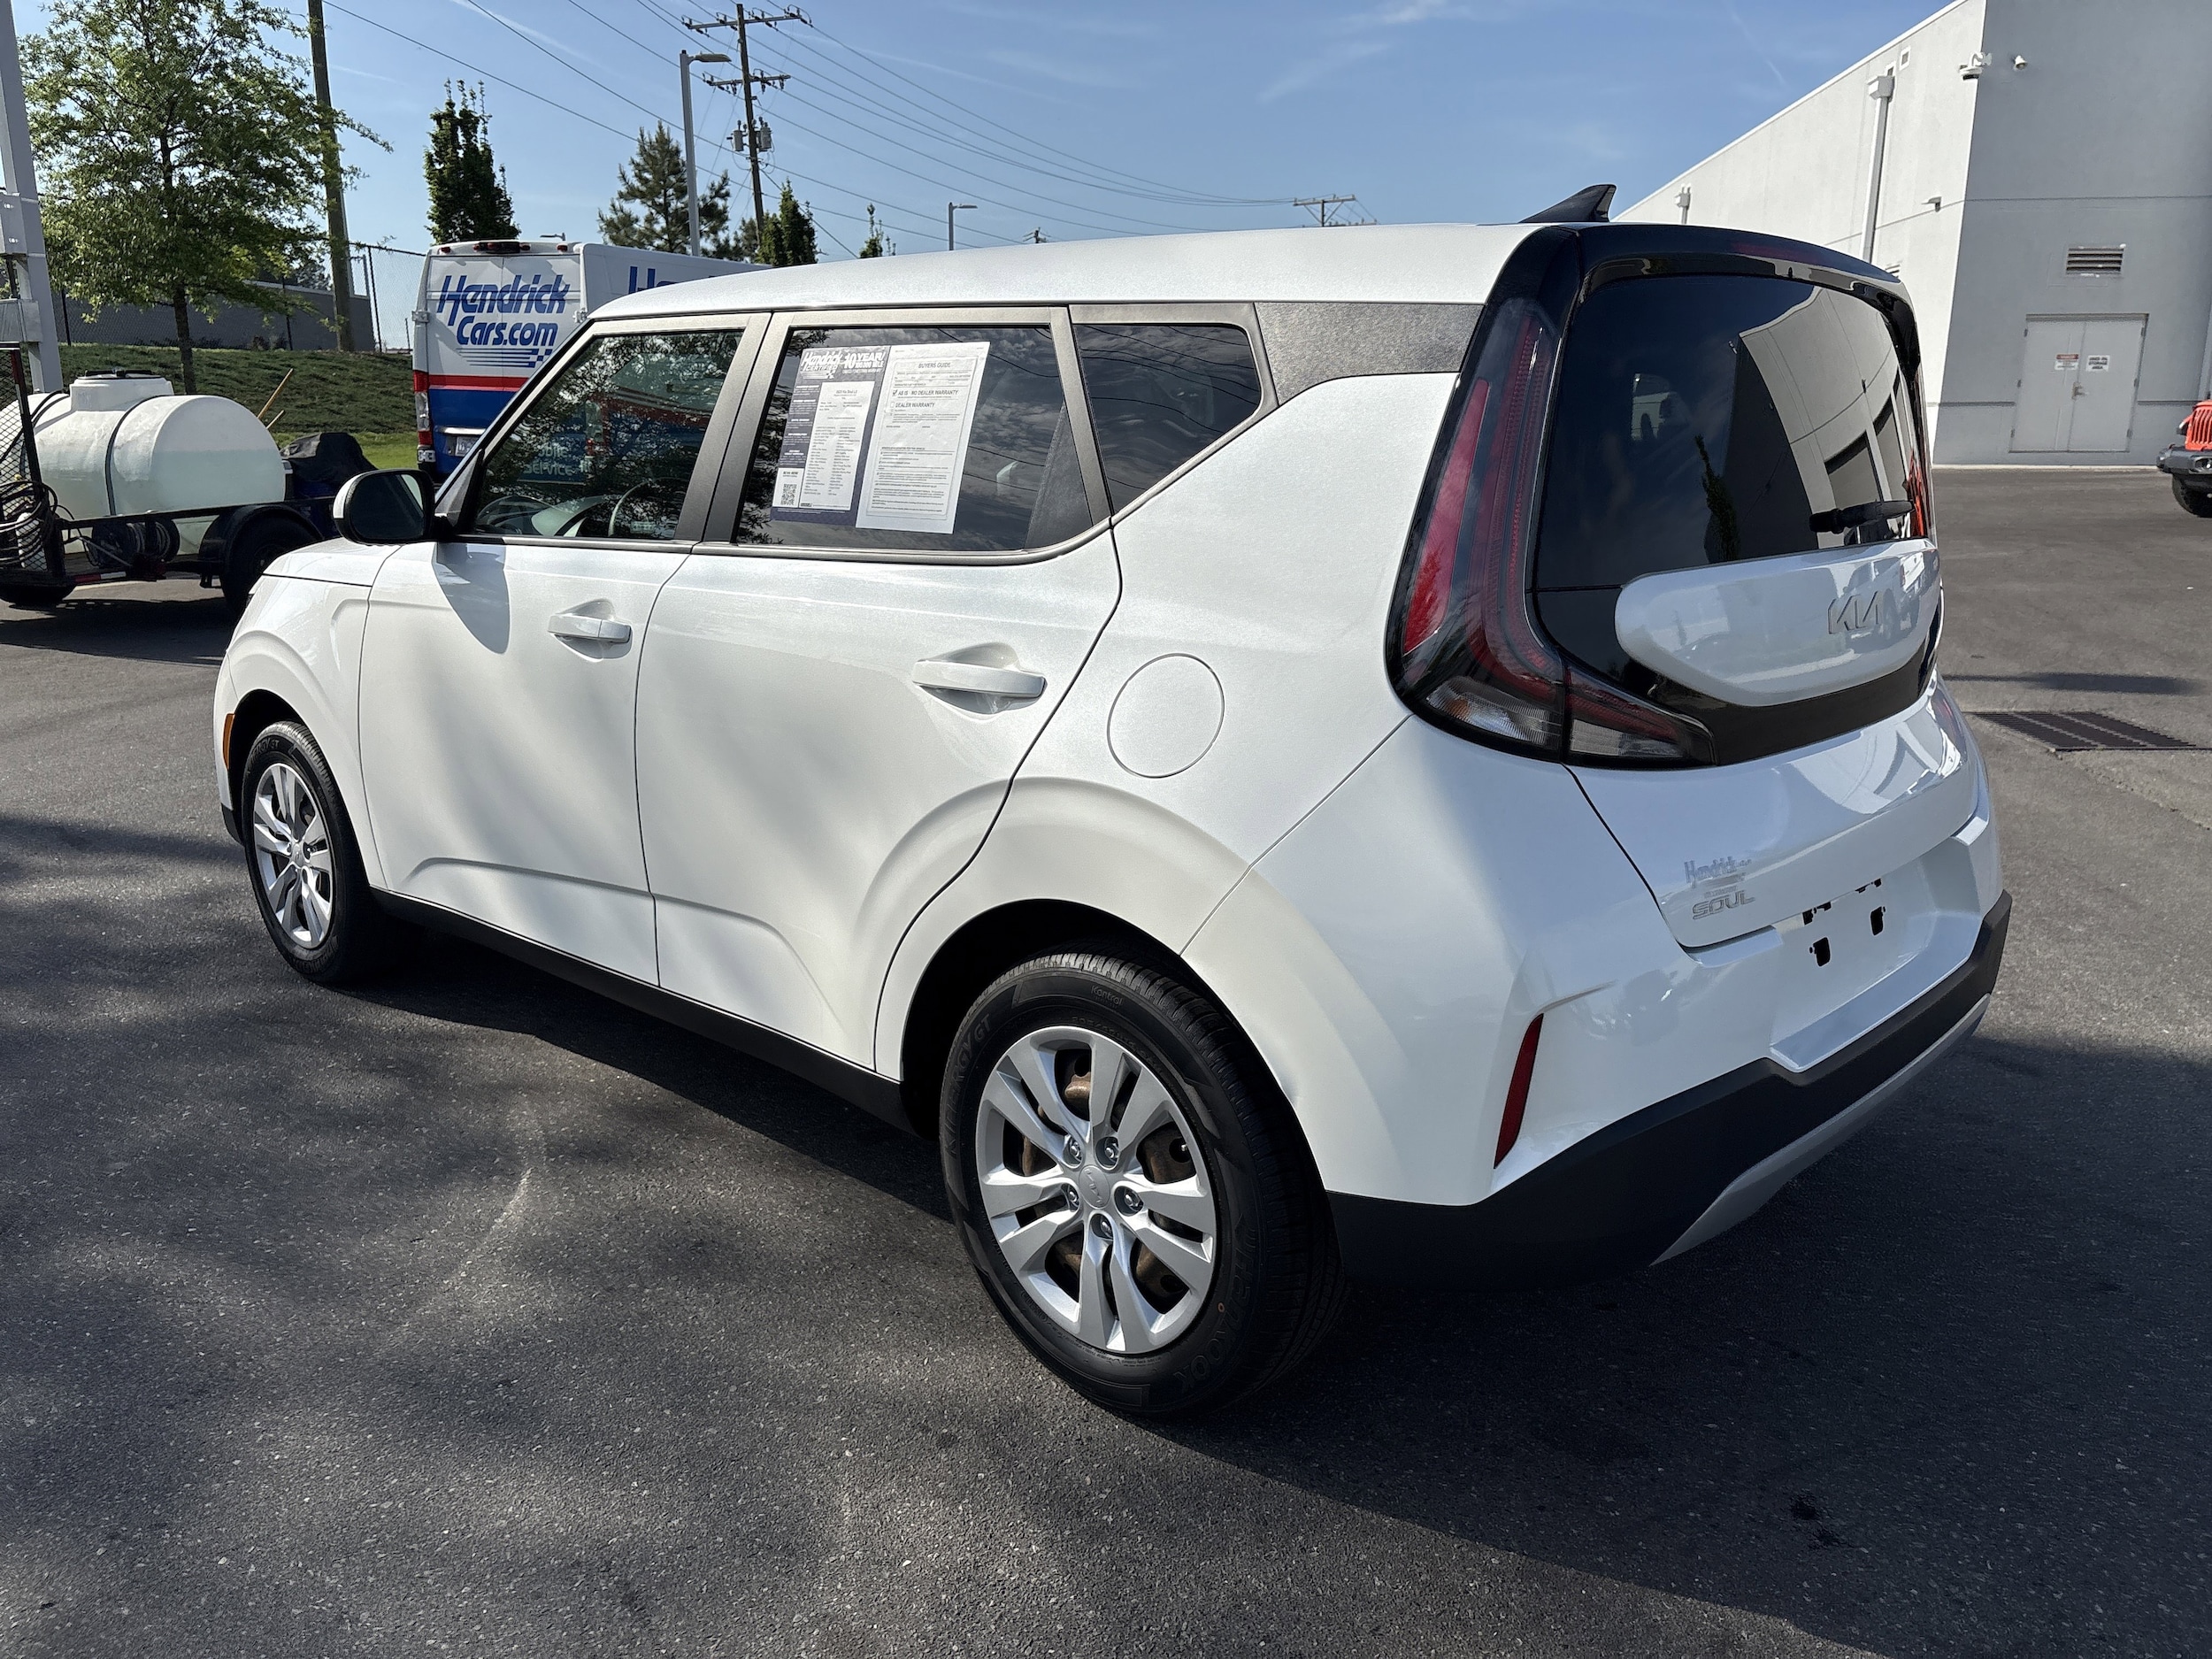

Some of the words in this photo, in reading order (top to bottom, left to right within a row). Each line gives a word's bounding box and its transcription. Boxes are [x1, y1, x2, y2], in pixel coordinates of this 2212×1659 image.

[437, 274, 571, 326] Hendrick
[457, 315, 558, 347] Cars.com
[801, 351, 842, 371] Hendrick
[843, 352, 856, 369] 10
[1692, 889, 1756, 920] SOUL
[1091, 986, 1123, 1006] Kontrol
[973, 1013, 992, 1042] GT
